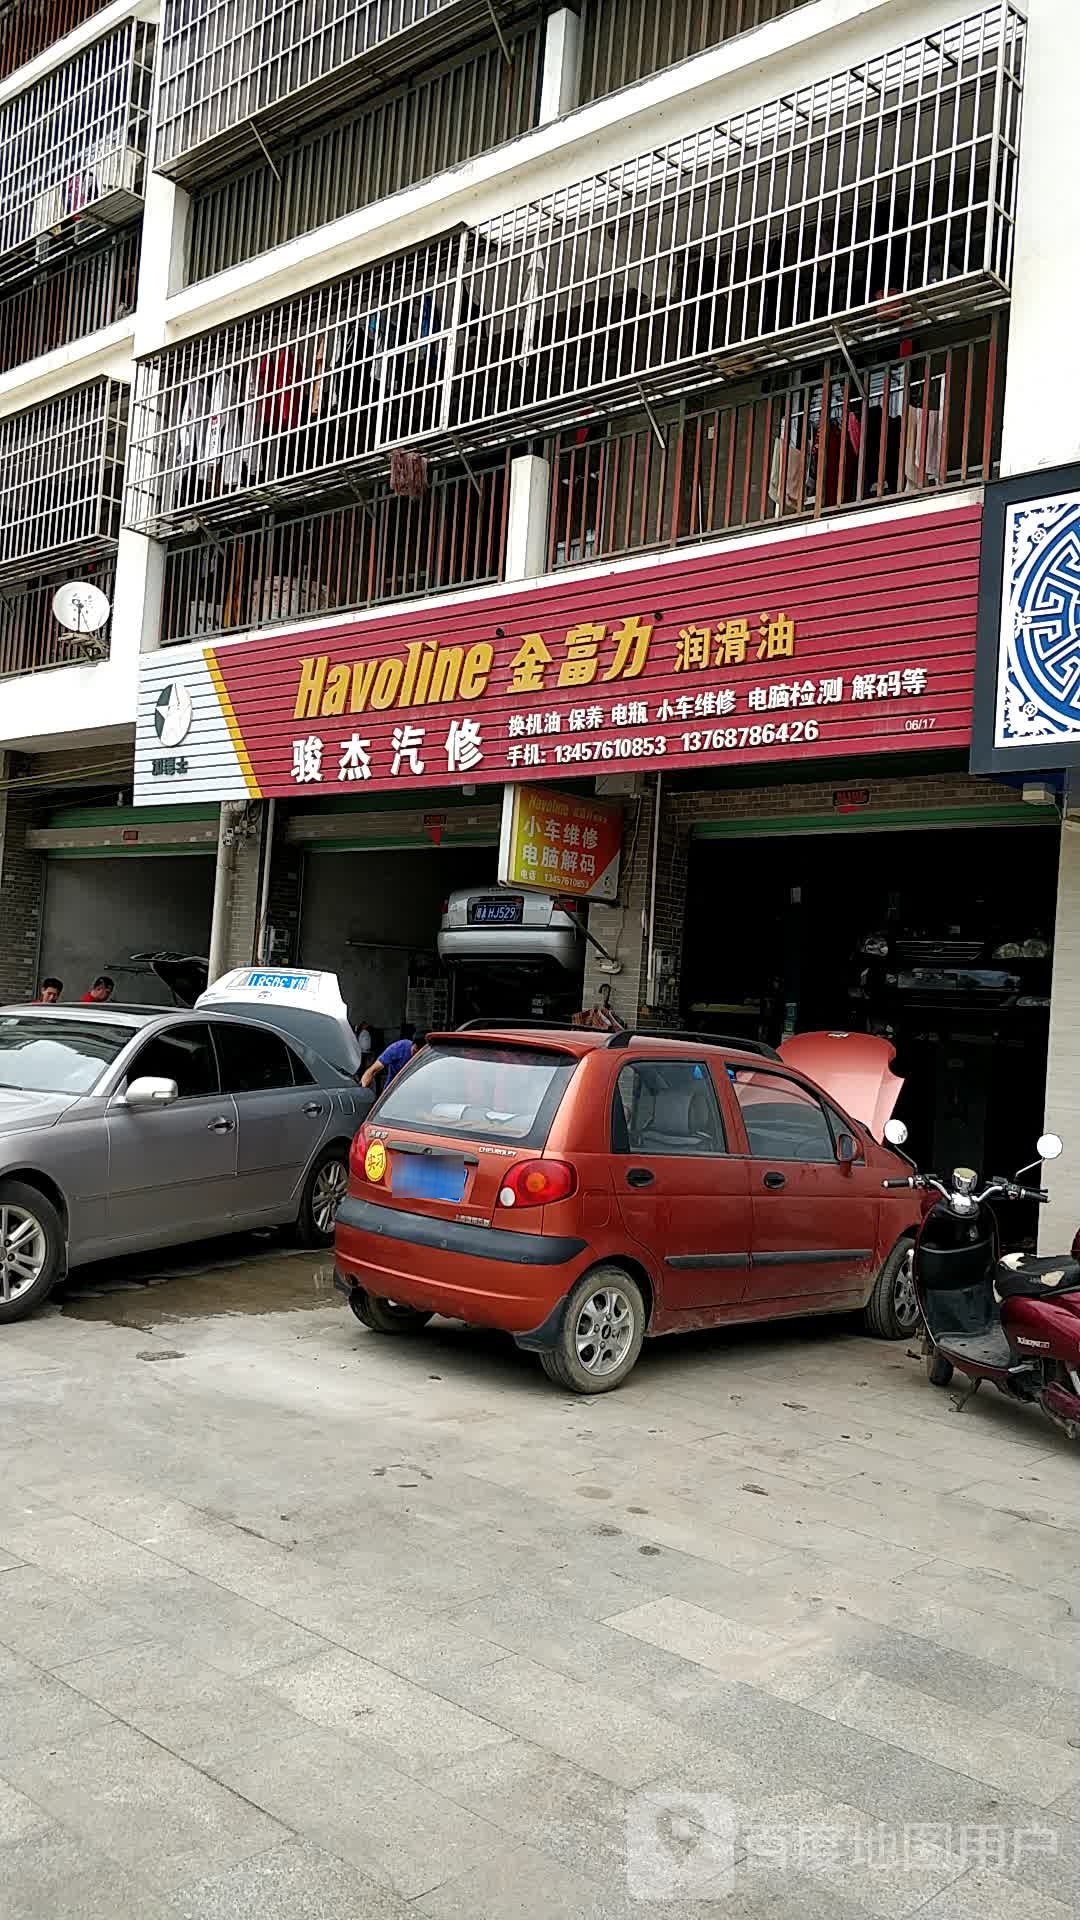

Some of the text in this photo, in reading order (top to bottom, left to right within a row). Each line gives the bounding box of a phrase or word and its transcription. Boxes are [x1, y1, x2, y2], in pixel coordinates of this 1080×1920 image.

[505, 616, 655, 693] 金富力
[673, 612, 796, 673] 润滑油
[293, 639, 495, 719] Havoline
[508, 667, 928, 737] 换机油 保养 电瓶 小车维修 电脑检测 解码等
[290, 718, 485, 784] 骏杰汽修
[553, 736, 666, 764] 13457610853
[680, 719, 819, 753] 13768786426
[905, 718, 936, 731] 06/17
[524, 815, 598, 850] 小车维修
[522, 843, 595, 877] 电脑解码
[367, 1152, 384, 1172] 实习
